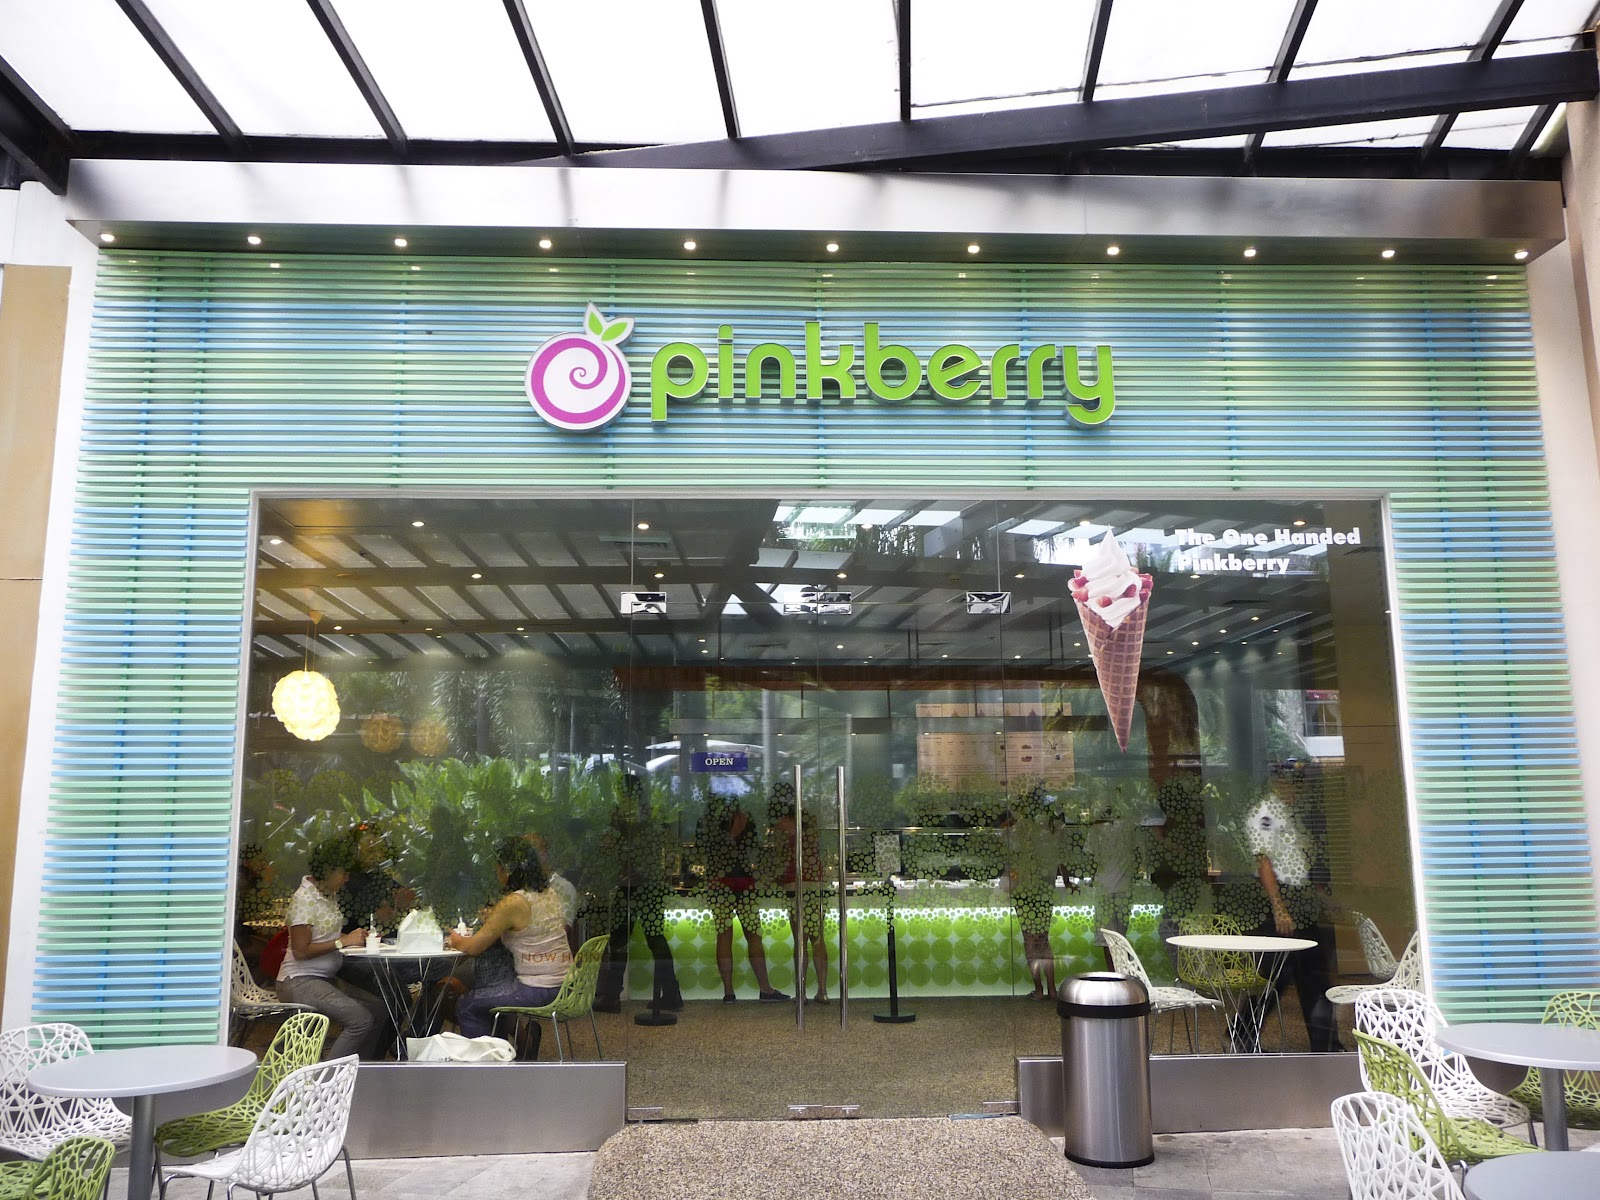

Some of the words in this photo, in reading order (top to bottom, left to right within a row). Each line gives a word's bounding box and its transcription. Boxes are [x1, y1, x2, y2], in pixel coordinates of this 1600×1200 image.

[650, 321, 1116, 428] pinkberry
[1174, 527, 1215, 546] The
[1222, 527, 1268, 546] One
[1274, 527, 1361, 545] Handed
[1177, 553, 1290, 574] Pinkberry
[705, 758, 734, 766] OPEN
[521, 952, 557, 963] NOW
